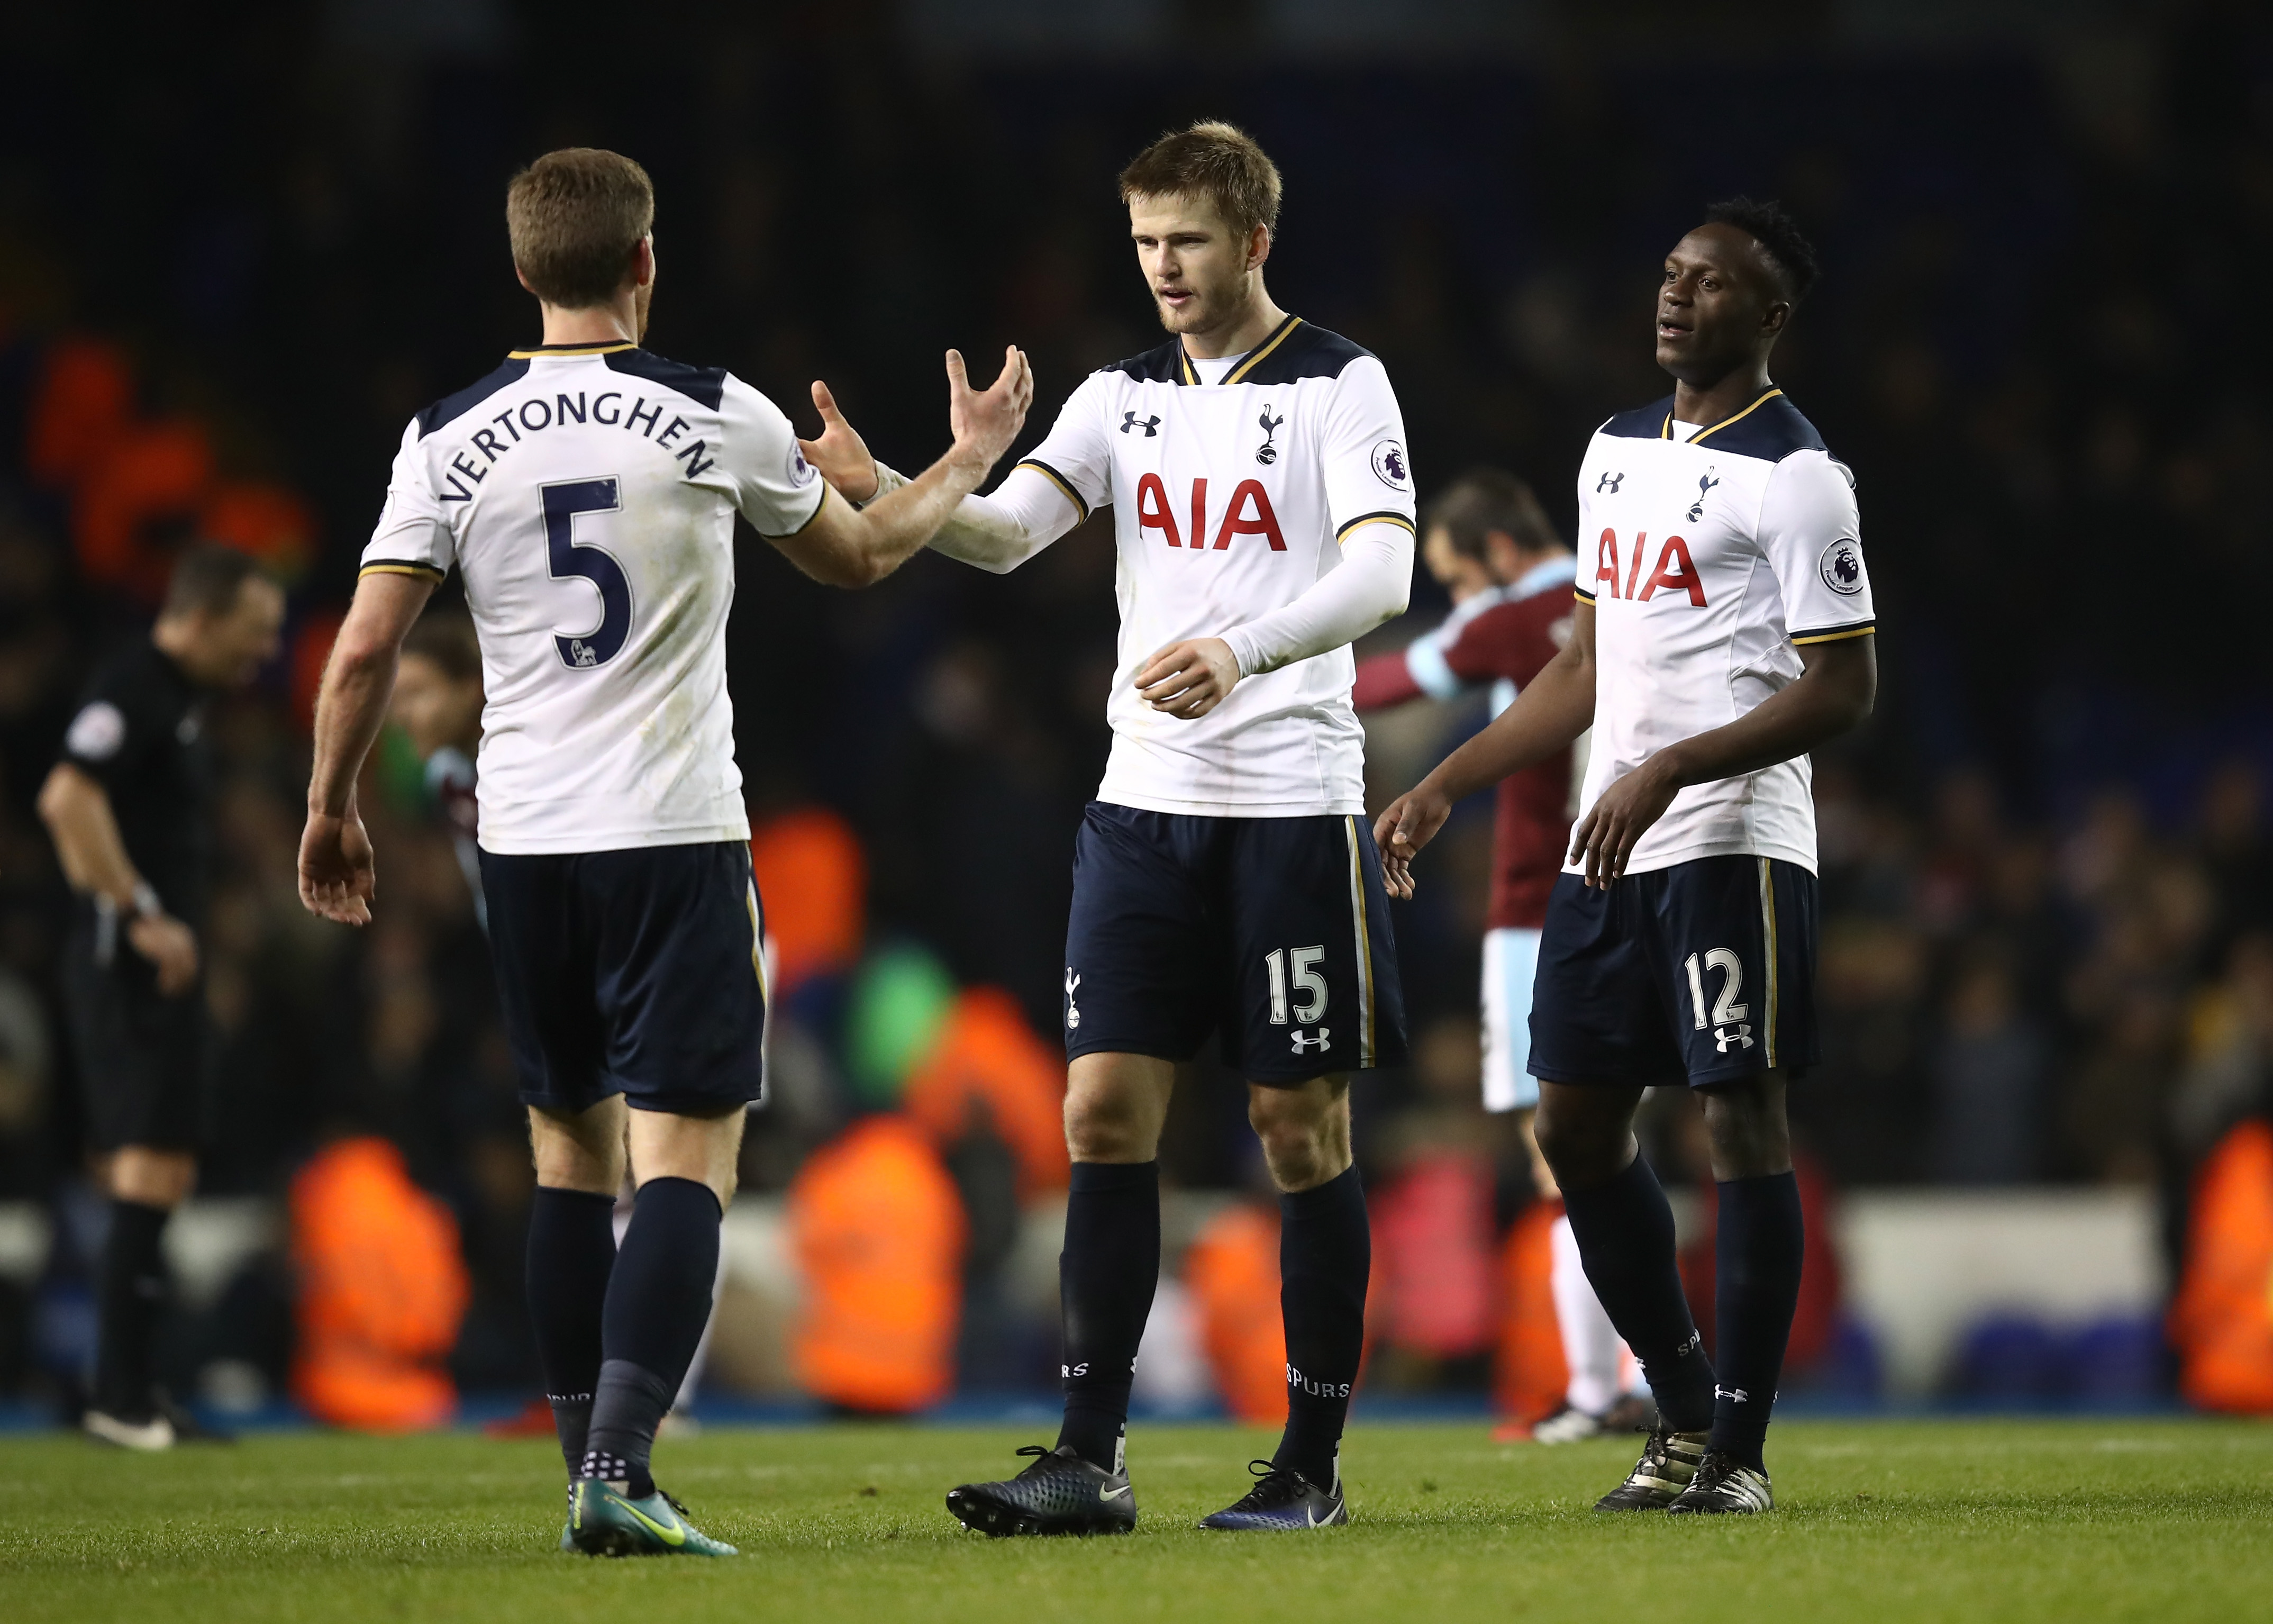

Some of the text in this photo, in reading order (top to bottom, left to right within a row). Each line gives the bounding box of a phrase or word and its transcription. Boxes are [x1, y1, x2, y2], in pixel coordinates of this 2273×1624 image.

[440, 392, 713, 502] VERTONGHEN
[1138, 473, 1287, 551] AIA
[538, 475, 635, 671] 5
[1595, 528, 1707, 607] AIA
[1265, 945, 1328, 1024] 15
[1685, 948, 1749, 1030] 12
[1286, 1363, 1350, 1398] SPURS
